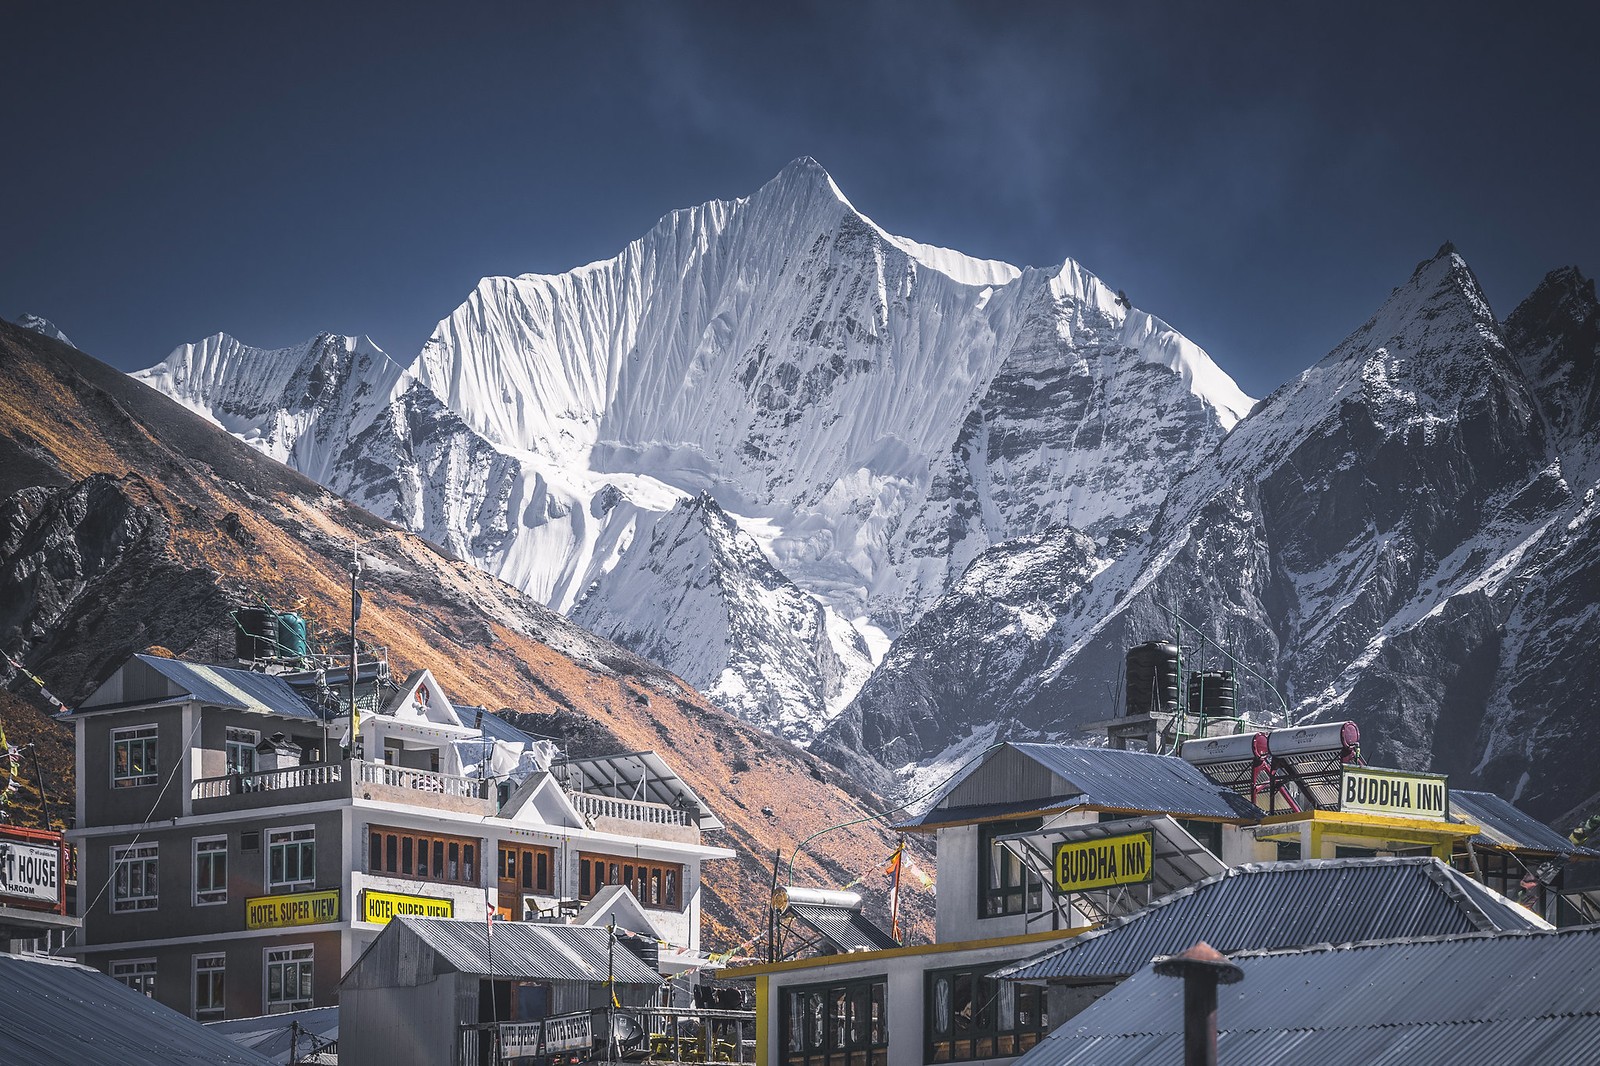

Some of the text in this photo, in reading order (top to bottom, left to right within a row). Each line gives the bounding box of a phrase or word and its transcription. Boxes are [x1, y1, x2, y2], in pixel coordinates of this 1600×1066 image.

[1346, 776, 1443, 811] BUDDHA INN
[19, 855, 56, 888] HOUSE
[1062, 842, 1145, 884] BUDDHA INN
[251, 898, 335, 924] HOTEL SUPER VIEW
[370, 898, 393, 919] HOTEL
[518, 1025, 540, 1046] EVEREST
[547, 1015, 591, 1043] HOTEL EVEREST
